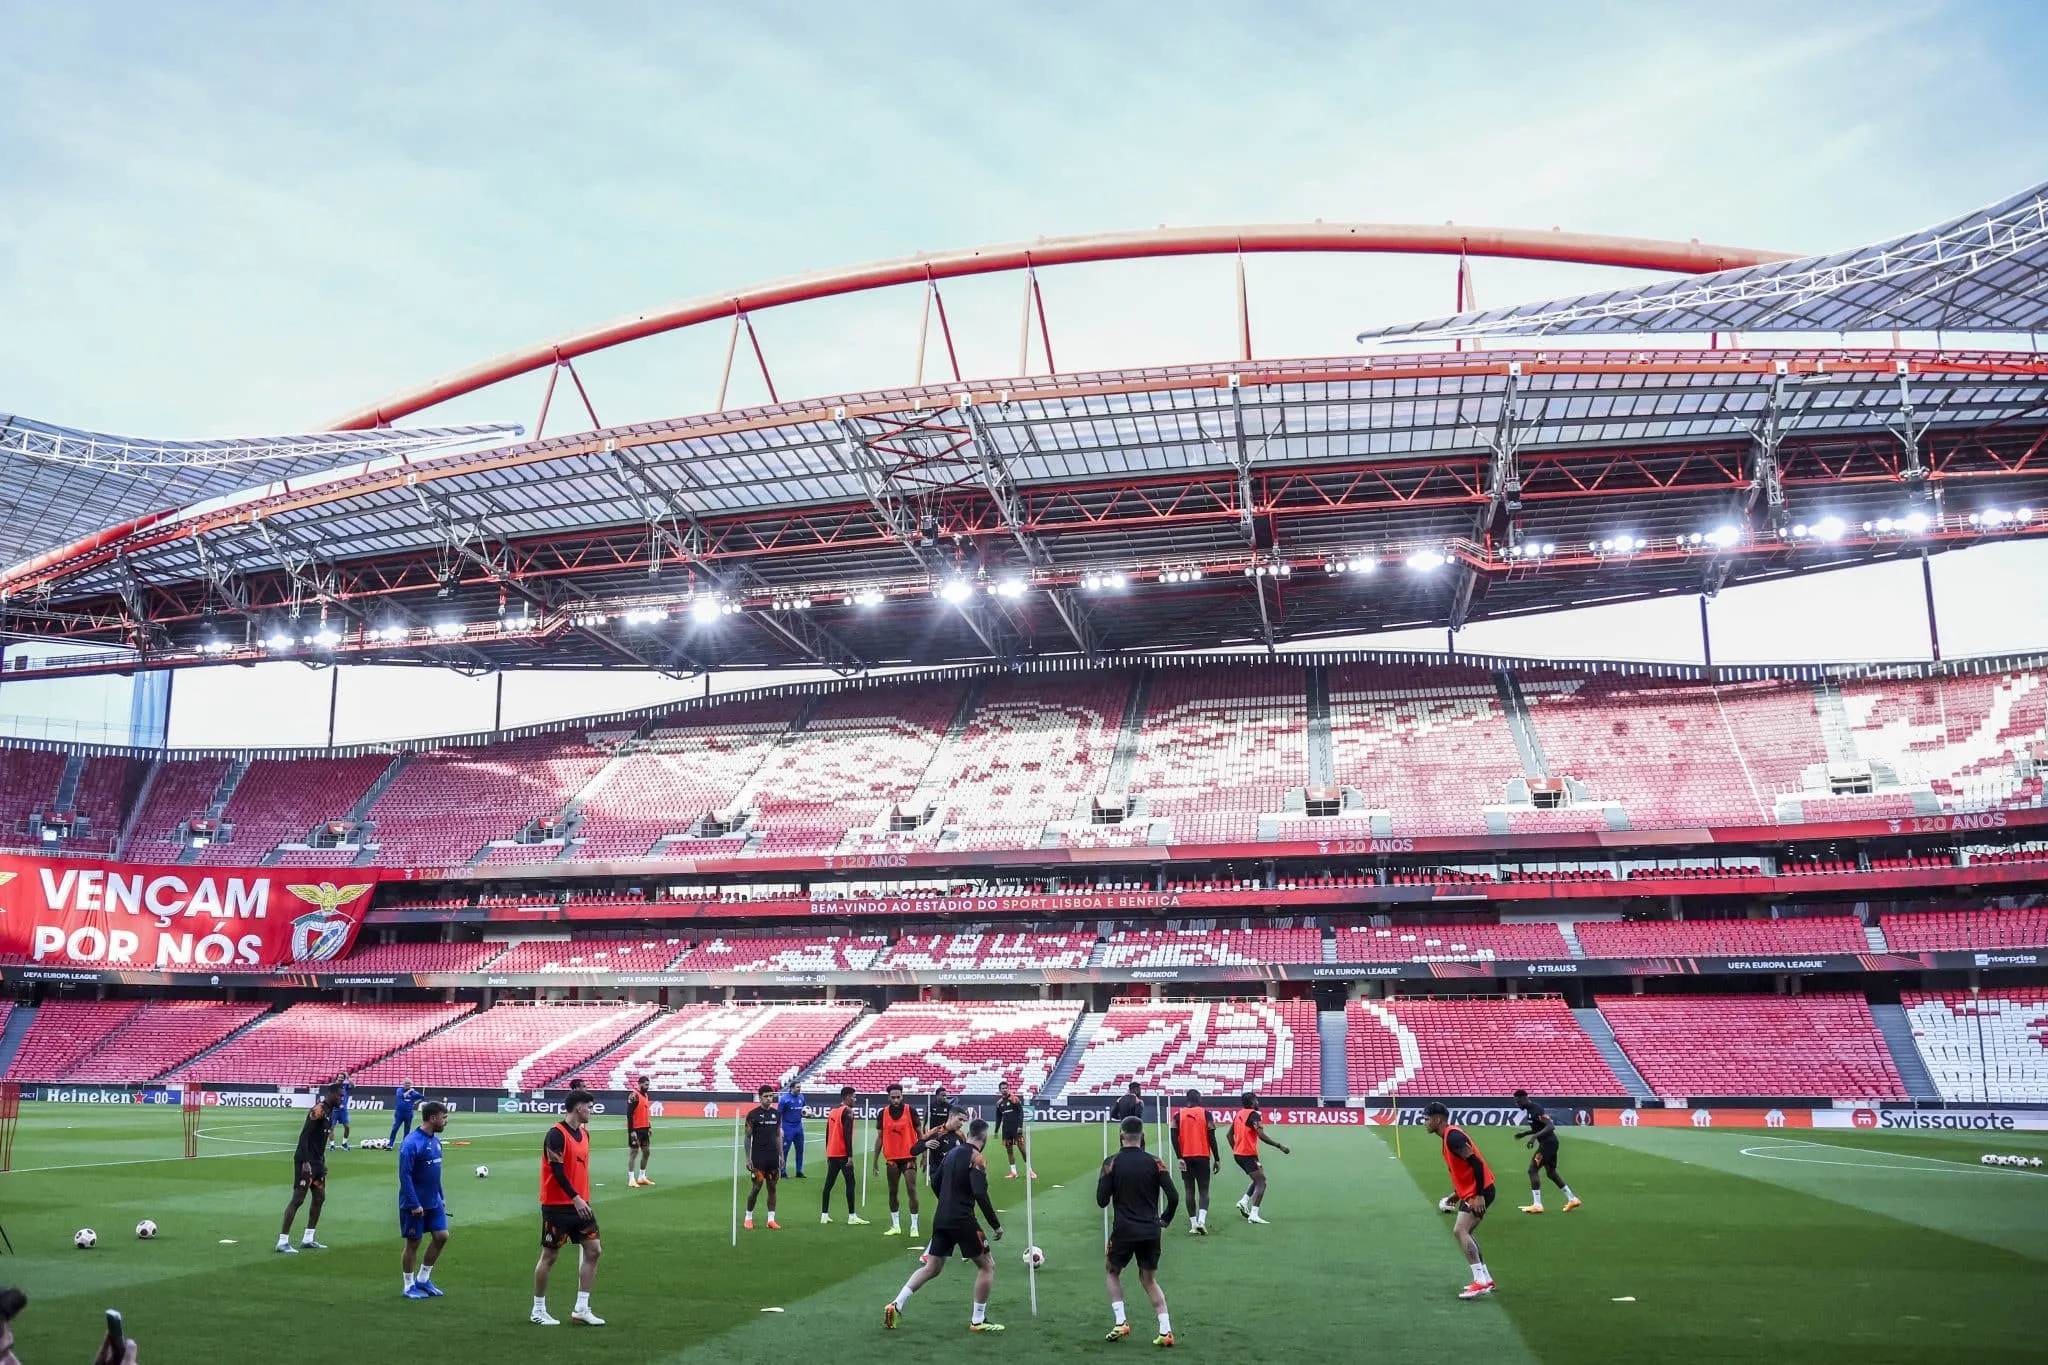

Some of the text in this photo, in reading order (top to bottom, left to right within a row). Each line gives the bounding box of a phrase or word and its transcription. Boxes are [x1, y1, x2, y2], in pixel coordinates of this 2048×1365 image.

[1911, 812, 2007, 832] 120 ANOS
[1337, 839, 1414, 853] 120 ANOS
[841, 855, 908, 868] 120 ANOS
[418, 868, 474, 879] 120 ANOS
[40, 868, 271, 928] VENÇAM
[811, 895, 1180, 913] BEM-VINDO AO ESTÁDIO DO SPORT LISBOA E BENFICA
[33, 921, 262, 965] POR NÓS
[1314, 968, 1335, 976] UEFA
[1335, 968, 1366, 976] EUROPA
[1537, 964, 1577, 973] STRAUSS
[1727, 961, 1751, 970] UEFA
[1752, 961, 1786, 969] EUROPA
[488, 976, 507, 985] bwin
[47, 1088, 131, 1104] Heineken
[347, 1095, 384, 1111] bwin
[499, 1100, 605, 1114] enterpe
[1022, 1106, 1121, 1122] enterpri
[1287, 1111, 1359, 1124] STRAUSS
[1880, 1110, 2015, 1129] Swissquote
